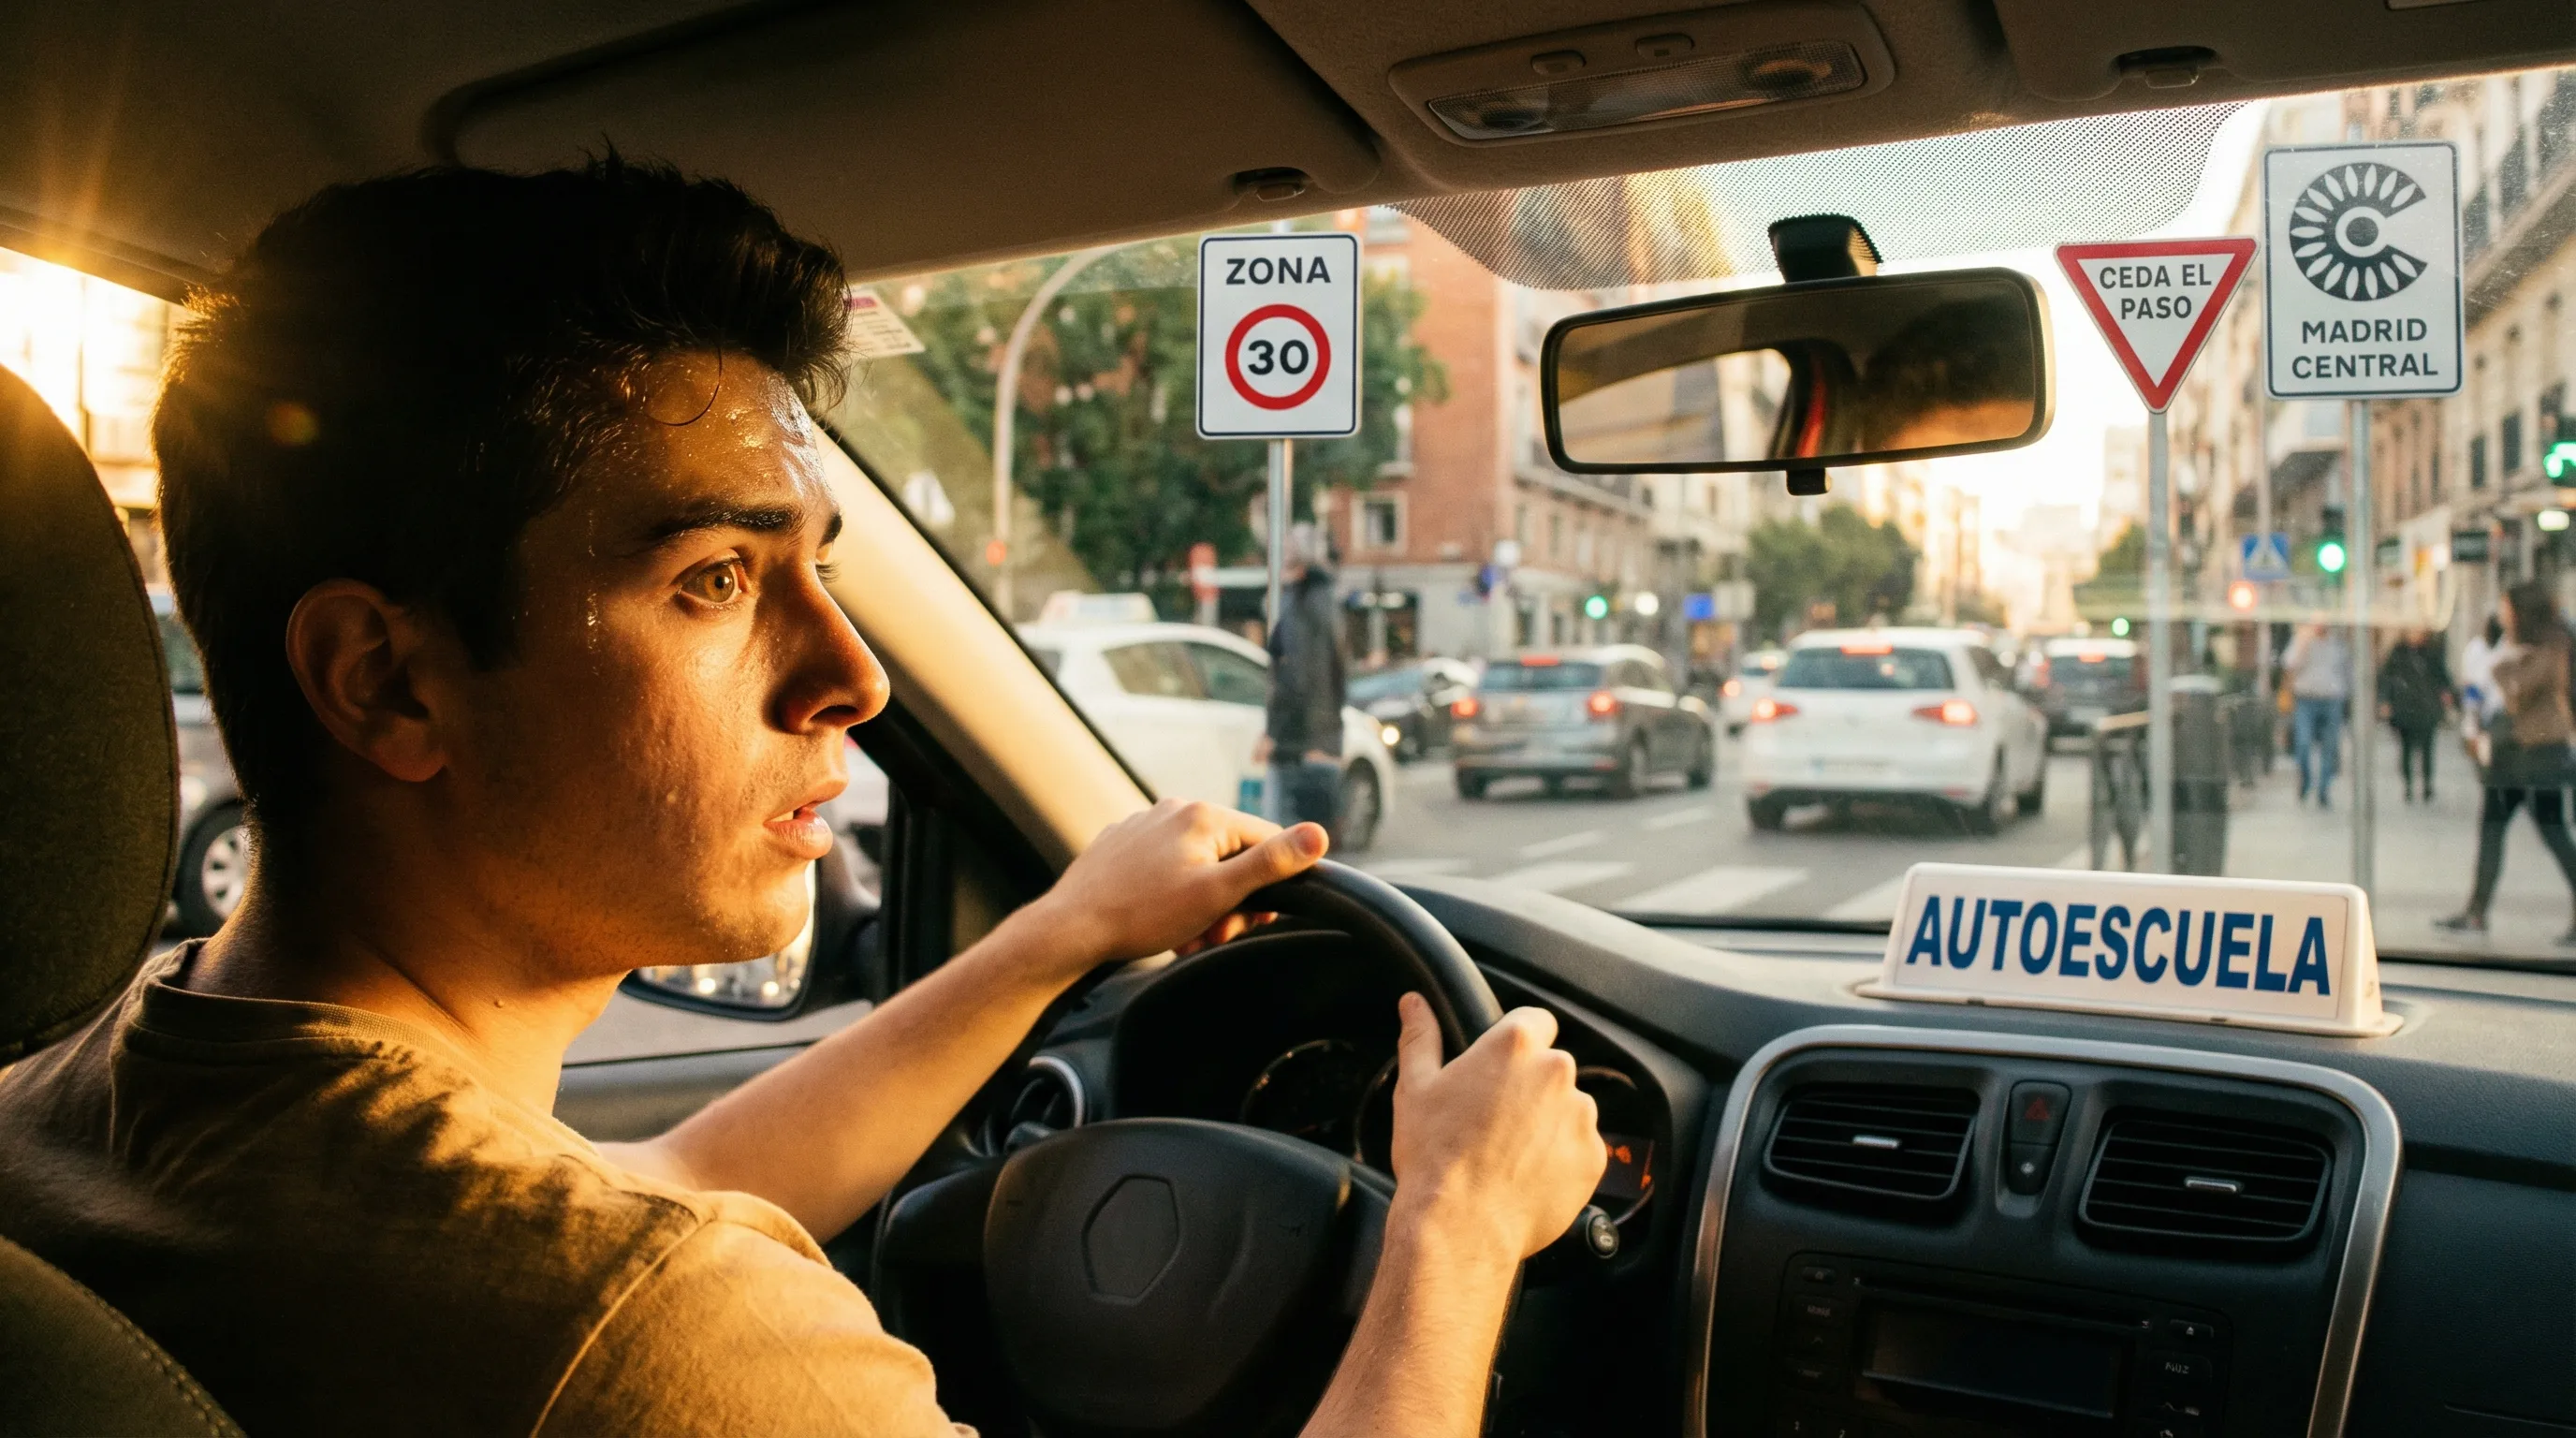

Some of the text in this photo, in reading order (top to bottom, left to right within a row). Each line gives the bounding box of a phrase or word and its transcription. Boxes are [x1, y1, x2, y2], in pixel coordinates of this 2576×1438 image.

[1225, 257, 1331, 285] ZONA
[2099, 263, 2212, 289] CEDA EL
[2121, 295, 2192, 320] PASO
[2302, 317, 2427, 345] MADRID
[1248, 339, 1310, 375] 30
[2291, 352, 2438, 380] CENTRAL
[1906, 896, 2331, 996] AUTOESCUELA
